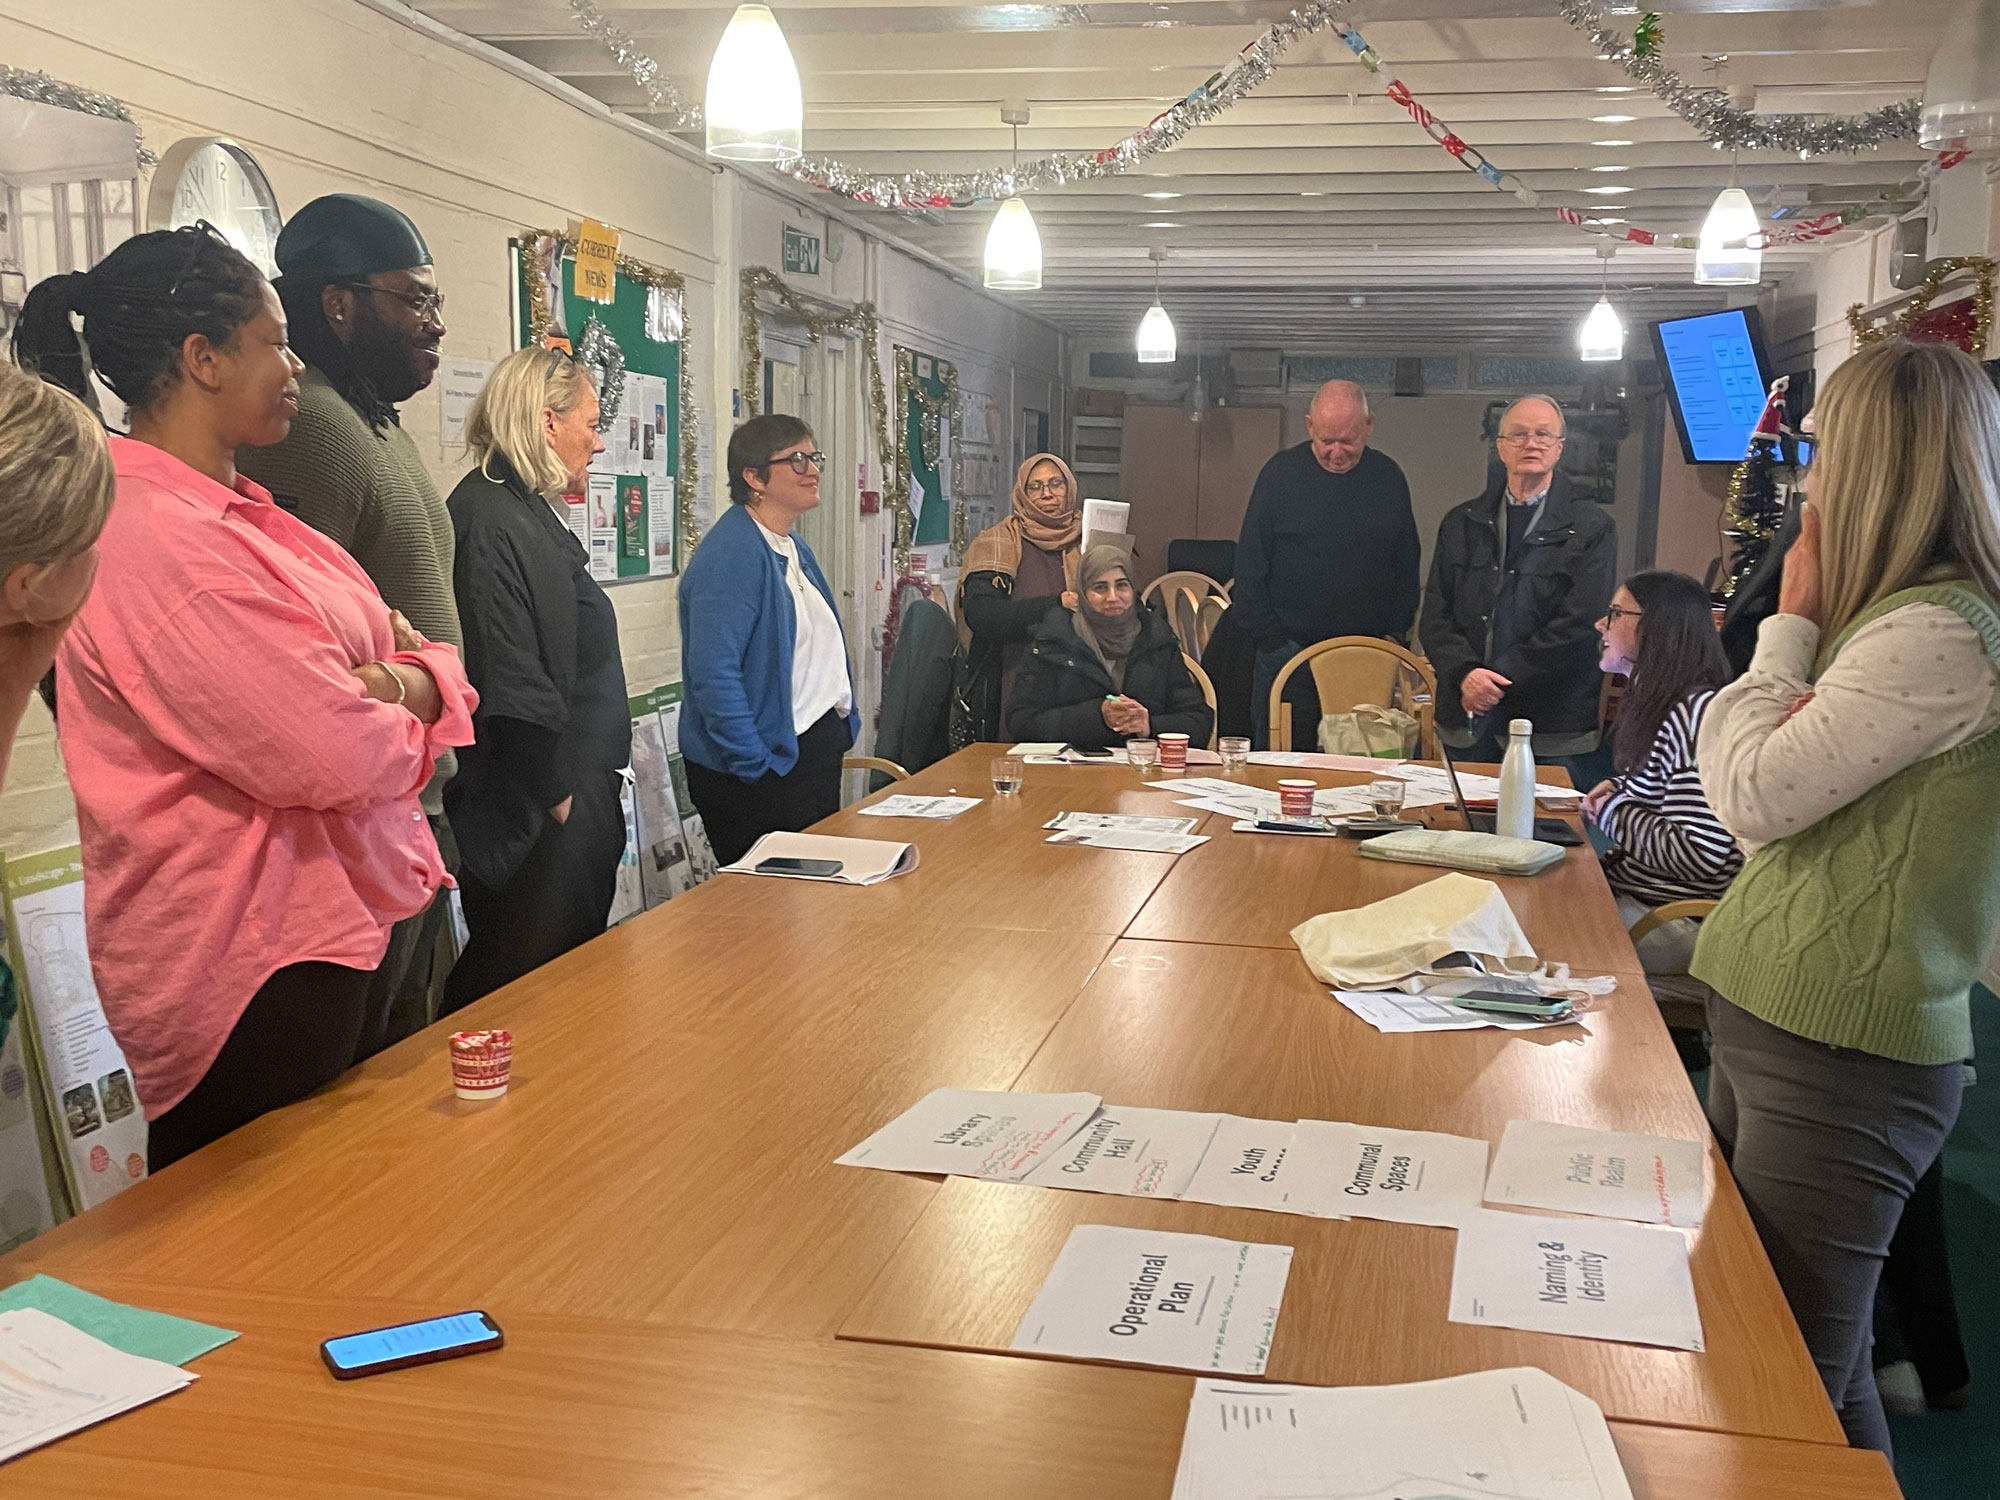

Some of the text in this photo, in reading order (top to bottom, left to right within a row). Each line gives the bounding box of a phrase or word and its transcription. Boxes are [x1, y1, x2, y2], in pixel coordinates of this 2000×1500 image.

[215, 160, 227, 181] 12
[580, 238, 617, 261] CURRENT
[584, 269, 607, 288] NEWS
[933, 1113, 992, 1144] Library
[1062, 1118, 1121, 1173] Community
[1104, 1138, 1136, 1158] Hall
[1230, 1148, 1267, 1174] Youth
[1344, 1142, 1383, 1196] Communal
[1379, 1155, 1411, 1192] Spaces
[1566, 1152, 1594, 1185] Public
[1600, 1156, 1626, 1188] Realm
[1537, 1241, 1573, 1304] Naming &
[1575, 1250, 1608, 1302] Identity
[1109, 1253, 1169, 1337] Operational
[1158, 1281, 1195, 1314] Plan
